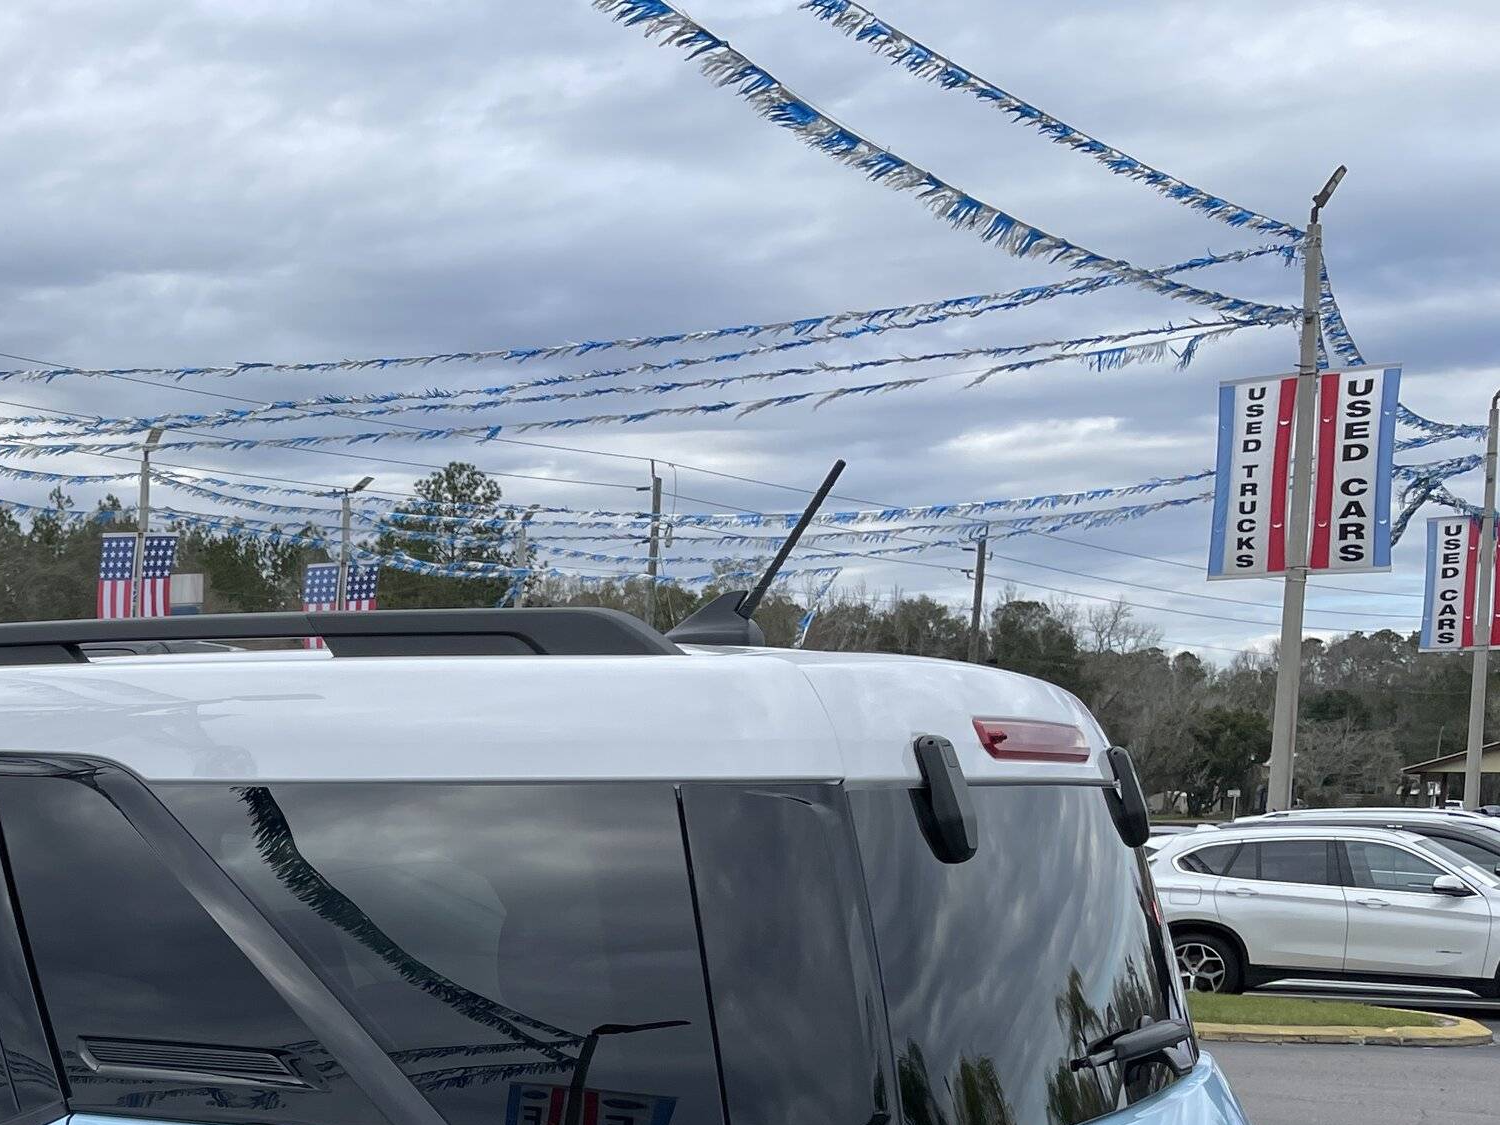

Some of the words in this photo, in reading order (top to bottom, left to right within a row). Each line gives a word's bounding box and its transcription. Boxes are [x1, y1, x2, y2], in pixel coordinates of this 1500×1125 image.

[1242, 386, 1267, 453] USED
[1342, 378, 1374, 462] USED
[1235, 464, 1259, 568] TRUCKS
[1338, 478, 1368, 562] CARS
[1441, 524, 1462, 579] USED
[1437, 589, 1458, 644] CARS
